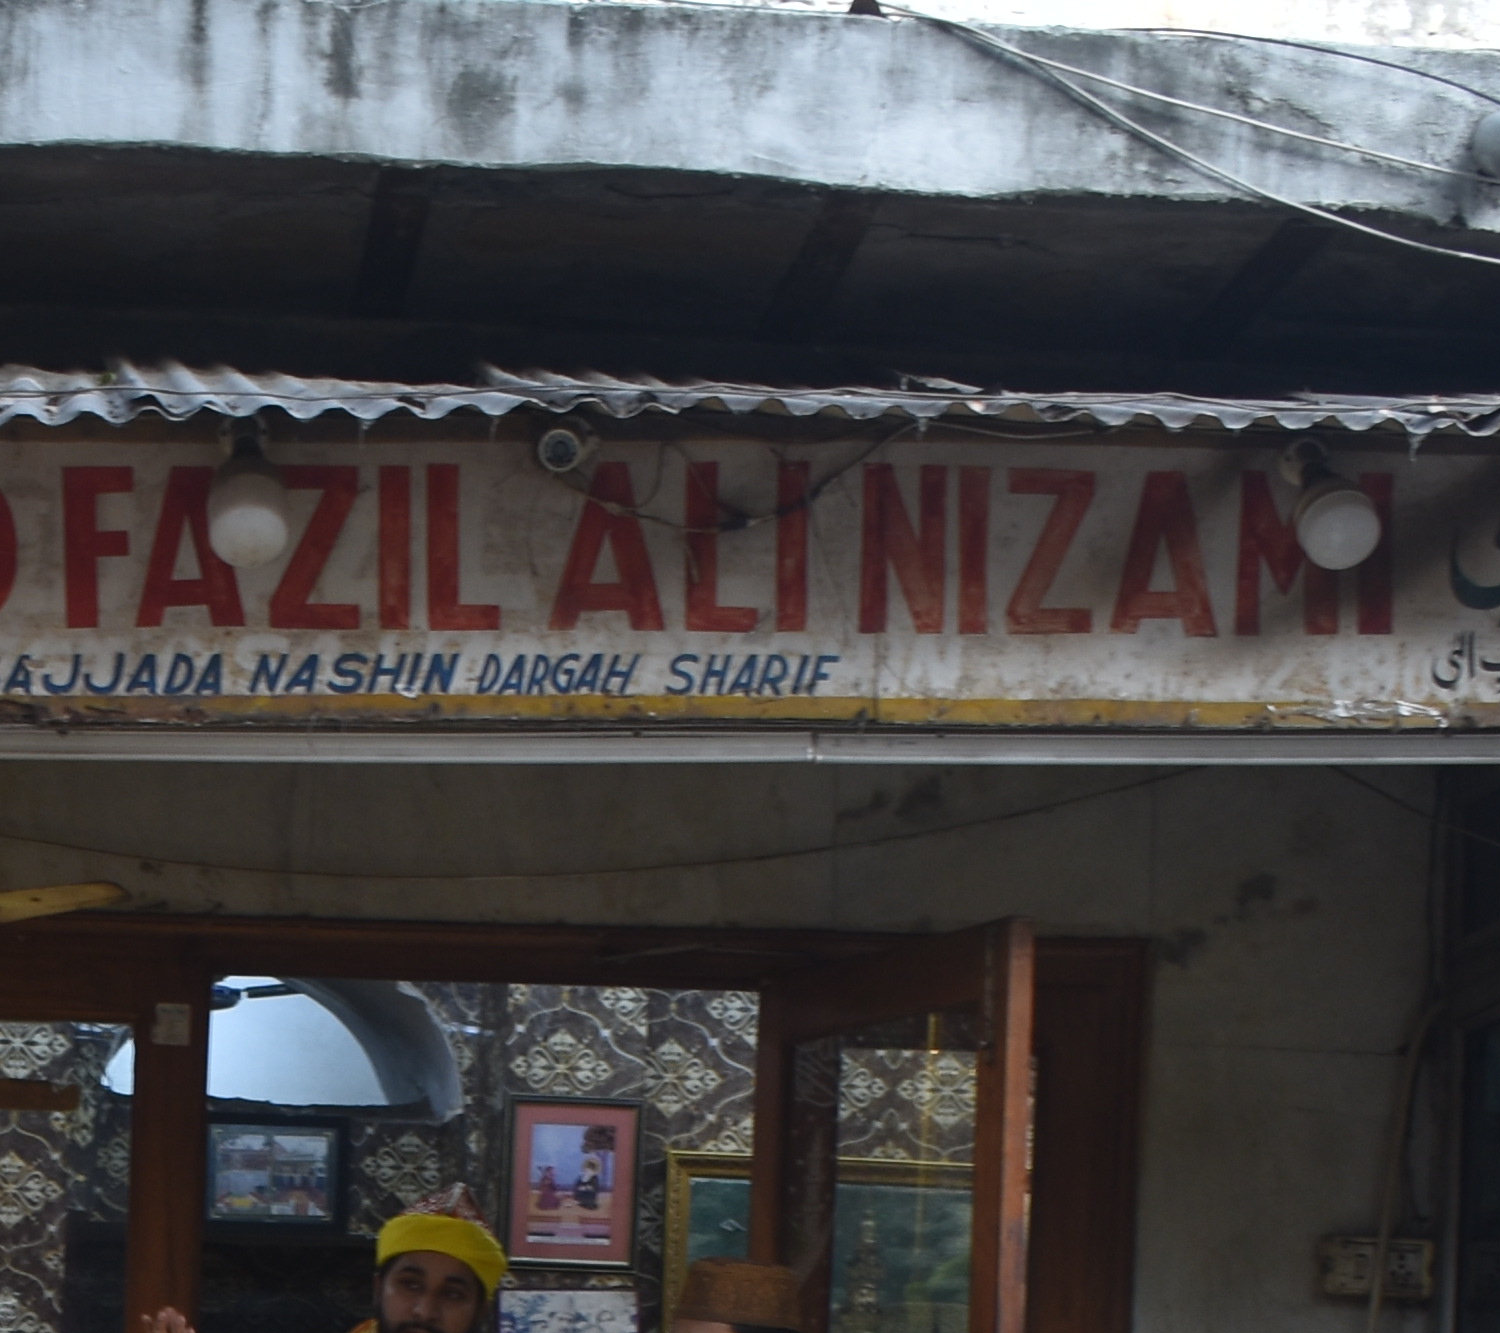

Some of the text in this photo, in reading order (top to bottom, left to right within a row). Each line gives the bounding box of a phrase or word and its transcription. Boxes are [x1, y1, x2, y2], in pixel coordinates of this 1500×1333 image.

[62, 464, 499, 631] FAZIL
[548, 461, 811, 633] ALI
[858, 462, 1394, 637] NIZAMI
[250, 653, 459, 696] NASHIN
[477, 653, 640, 696] DARGAH
[666, 654, 841, 696] SHARIF
